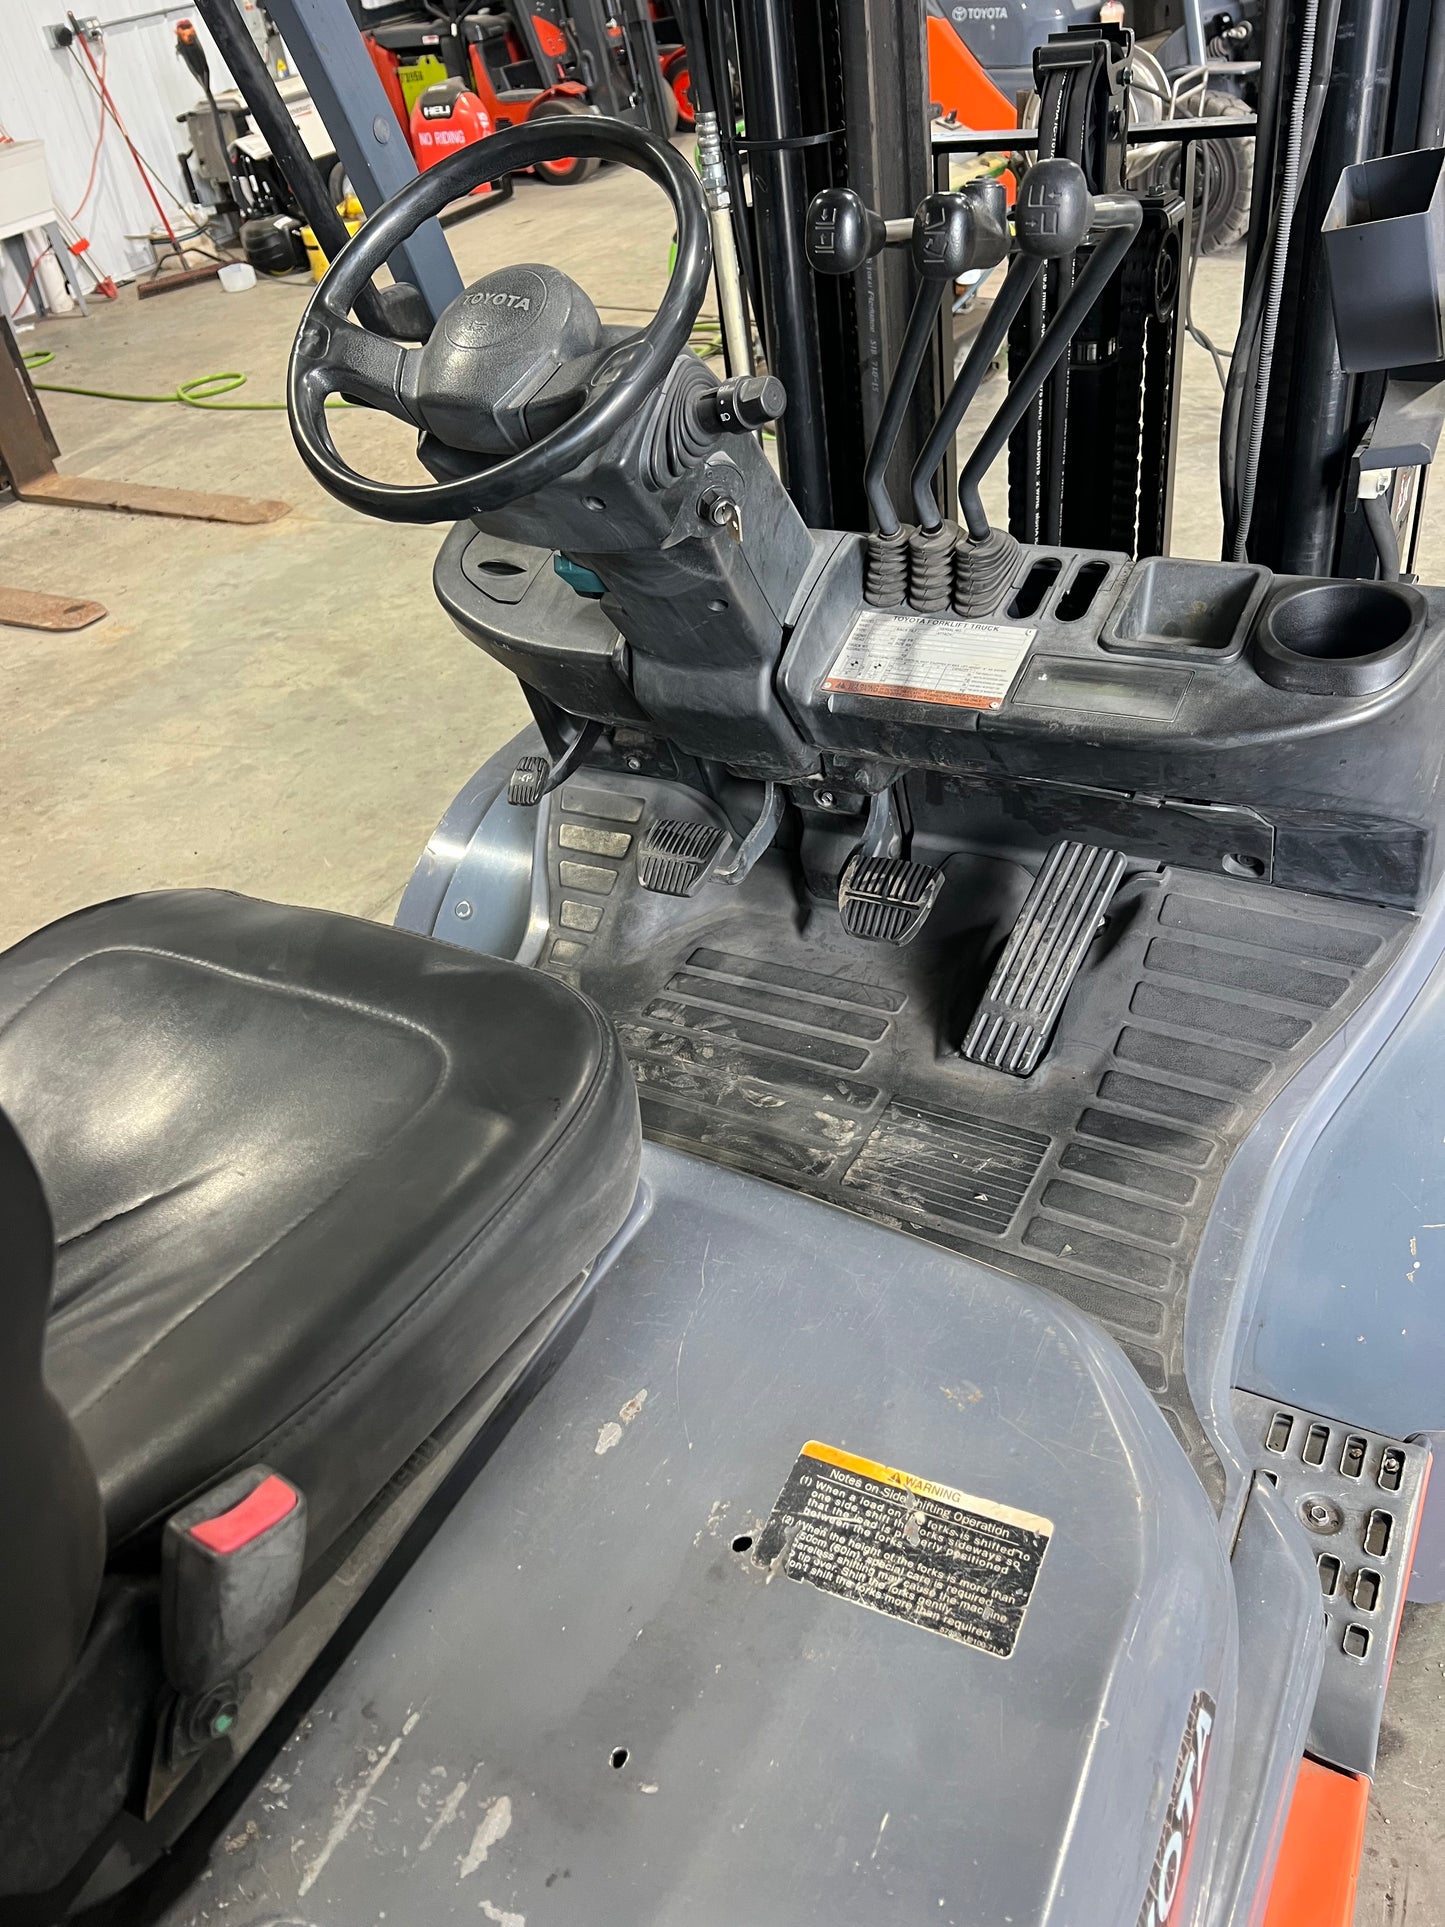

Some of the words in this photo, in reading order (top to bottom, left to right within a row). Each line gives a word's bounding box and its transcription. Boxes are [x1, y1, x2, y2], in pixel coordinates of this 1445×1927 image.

[968, 7, 1008, 19] TOYOTA
[423, 105, 451, 118] HELI
[418, 132, 433, 146] NO
[433, 130, 466, 145] RIDING
[463, 293, 531, 311] TOYOTA
[925, 619, 968, 627] FORKLIFT
[968, 623, 1000, 631] TRUCK
[829, 1469, 863, 1487] Notes
[864, 1483, 879, 1493] on
[952, 1511, 1010, 1538] Operation
[905, 1477, 961, 1502] WARNING
[798, 1475, 812, 1486] (1)
[815, 1481, 846, 1497] When
[860, 1496, 884, 1511] load
[888, 1508, 901, 1517] on
[927, 1520, 955, 1535] forks
[960, 1531, 970, 1540] is
[974, 1535, 1014, 1555] shifted
[811, 1491, 831, 1502] one
[865, 1508, 890, 1522] shift
[916, 1526, 944, 1541] orks
[947, 1537, 1002, 1563] sideways
[1006, 1559, 1020, 1568] so
[853, 1525, 870, 1536] the
[807, 1498, 828, 1510] that
[832, 1507, 849, 1518] the
[881, 1524, 890, 1532] is
[946, 1546, 1008, 1575] positioned
[781, 1514, 794, 1525] (2)
[829, 1532, 845, 1543] the
[847, 1539, 880, 1557] height
[883, 1551, 894, 1560] of
[897, 1556, 913, 1567] the
[917, 1563, 946, 1579] forks
[947, 1574, 956, 1582] is
[959, 1579, 987, 1593] more
[991, 1589, 1015, 1604] than
[797, 1553, 810, 1563] tip
[841, 1568, 865, 1581] Shift
[868, 1578, 884, 1589] the
[888, 1585, 914, 1599] forks
[865, 1555, 904, 1575] special
[906, 1572, 930, 1584] care
[934, 1580, 943, 1588] is
[786, 1558, 808, 1571] on't
[810, 1567, 832, 1580] shift
[835, 1576, 853, 1588] the
[855, 1583, 881, 1598] forks
[884, 1595, 911, 1610] more
[915, 1605, 939, 1620] than
[836, 1556, 875, 1576] shifting
[903, 1581, 935, 1597] cause
[939, 1593, 956, 1604] the
[959, 1600, 1007, 1623] macine
